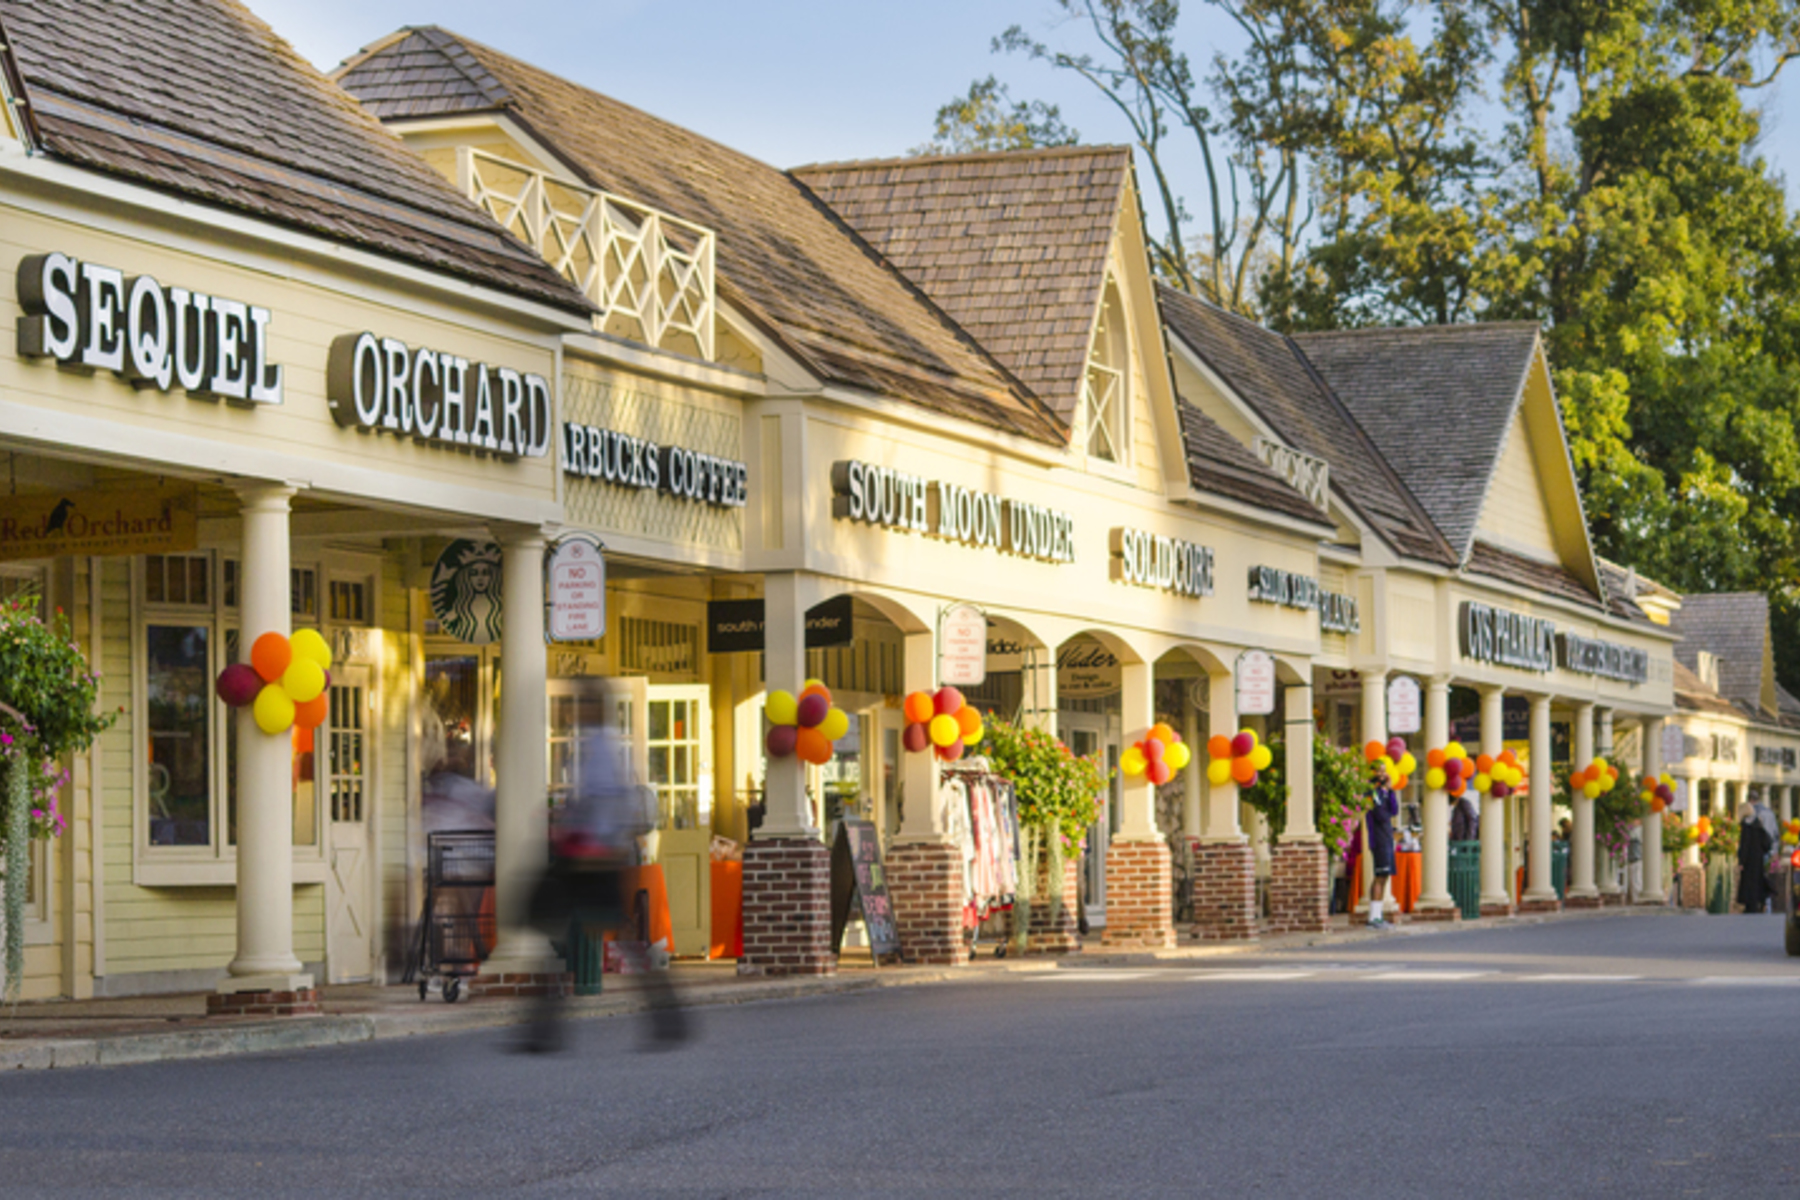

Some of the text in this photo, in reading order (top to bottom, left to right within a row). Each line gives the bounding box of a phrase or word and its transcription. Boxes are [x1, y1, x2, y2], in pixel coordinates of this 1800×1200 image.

[42, 251, 284, 405] SEQUEL
[353, 331, 551, 458] ORCHARD
[668, 445, 748, 508] COFFEE
[2, 505, 173, 541] Red Orchard
[849, 459, 1075, 564] SOUTH MOON UNDER
[568, 567, 587, 579] NO
[1122, 527, 1215, 598] SOLIDCORE
[558, 581, 597, 590] PARKING
[570, 591, 584, 600] OR
[565, 623, 589, 632] LANE
[567, 613, 587, 621] FIRE
[717, 619, 758, 633] south
